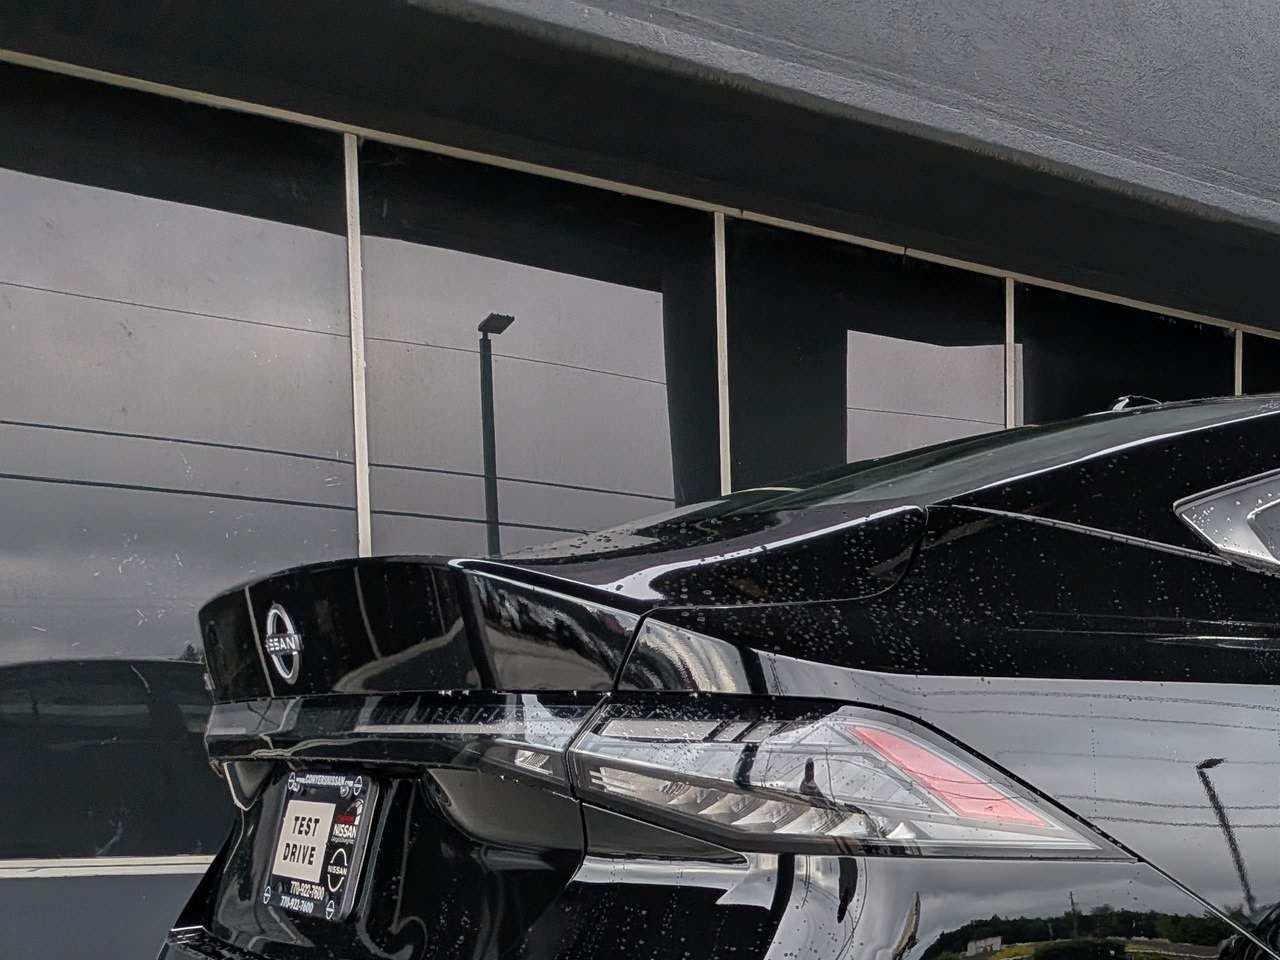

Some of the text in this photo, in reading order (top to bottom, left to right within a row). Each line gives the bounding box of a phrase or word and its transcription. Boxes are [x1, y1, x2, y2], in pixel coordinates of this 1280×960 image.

[292, 815, 321, 837] TEST
[332, 823, 357, 839] NISSAN
[282, 842, 316, 866] DRIVE
[327, 865, 348, 876] NISSAN
